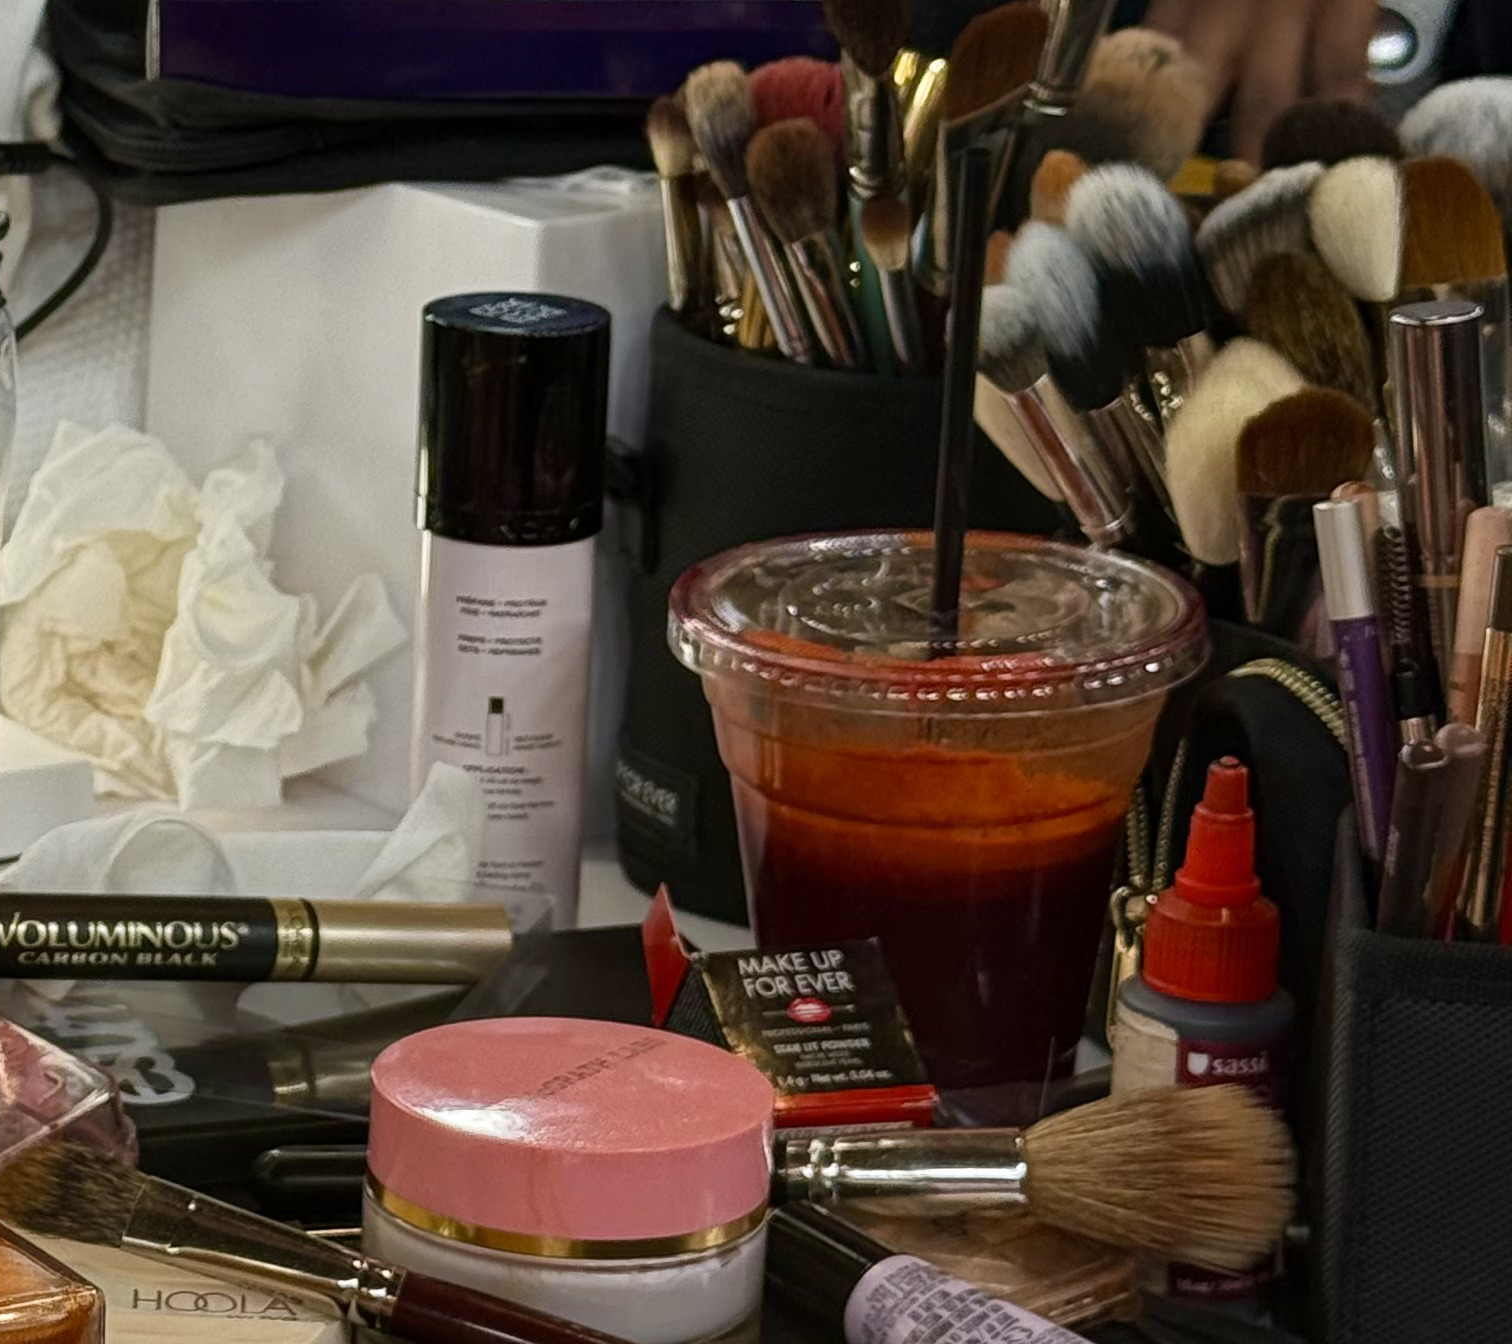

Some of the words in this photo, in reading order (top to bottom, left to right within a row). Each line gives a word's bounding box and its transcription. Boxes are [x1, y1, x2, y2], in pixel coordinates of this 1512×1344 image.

[17, 951, 128, 966] CARBON
[136, 951, 218, 967] BLACK
[738, 951, 809, 976] MAKE
[810, 949, 844, 969] UP
[743, 975, 794, 998] FOR
[794, 971, 856, 994] EVER
[820, 1038, 872, 1051] POWDER
[131, 1288, 298, 1317] HOOLA
